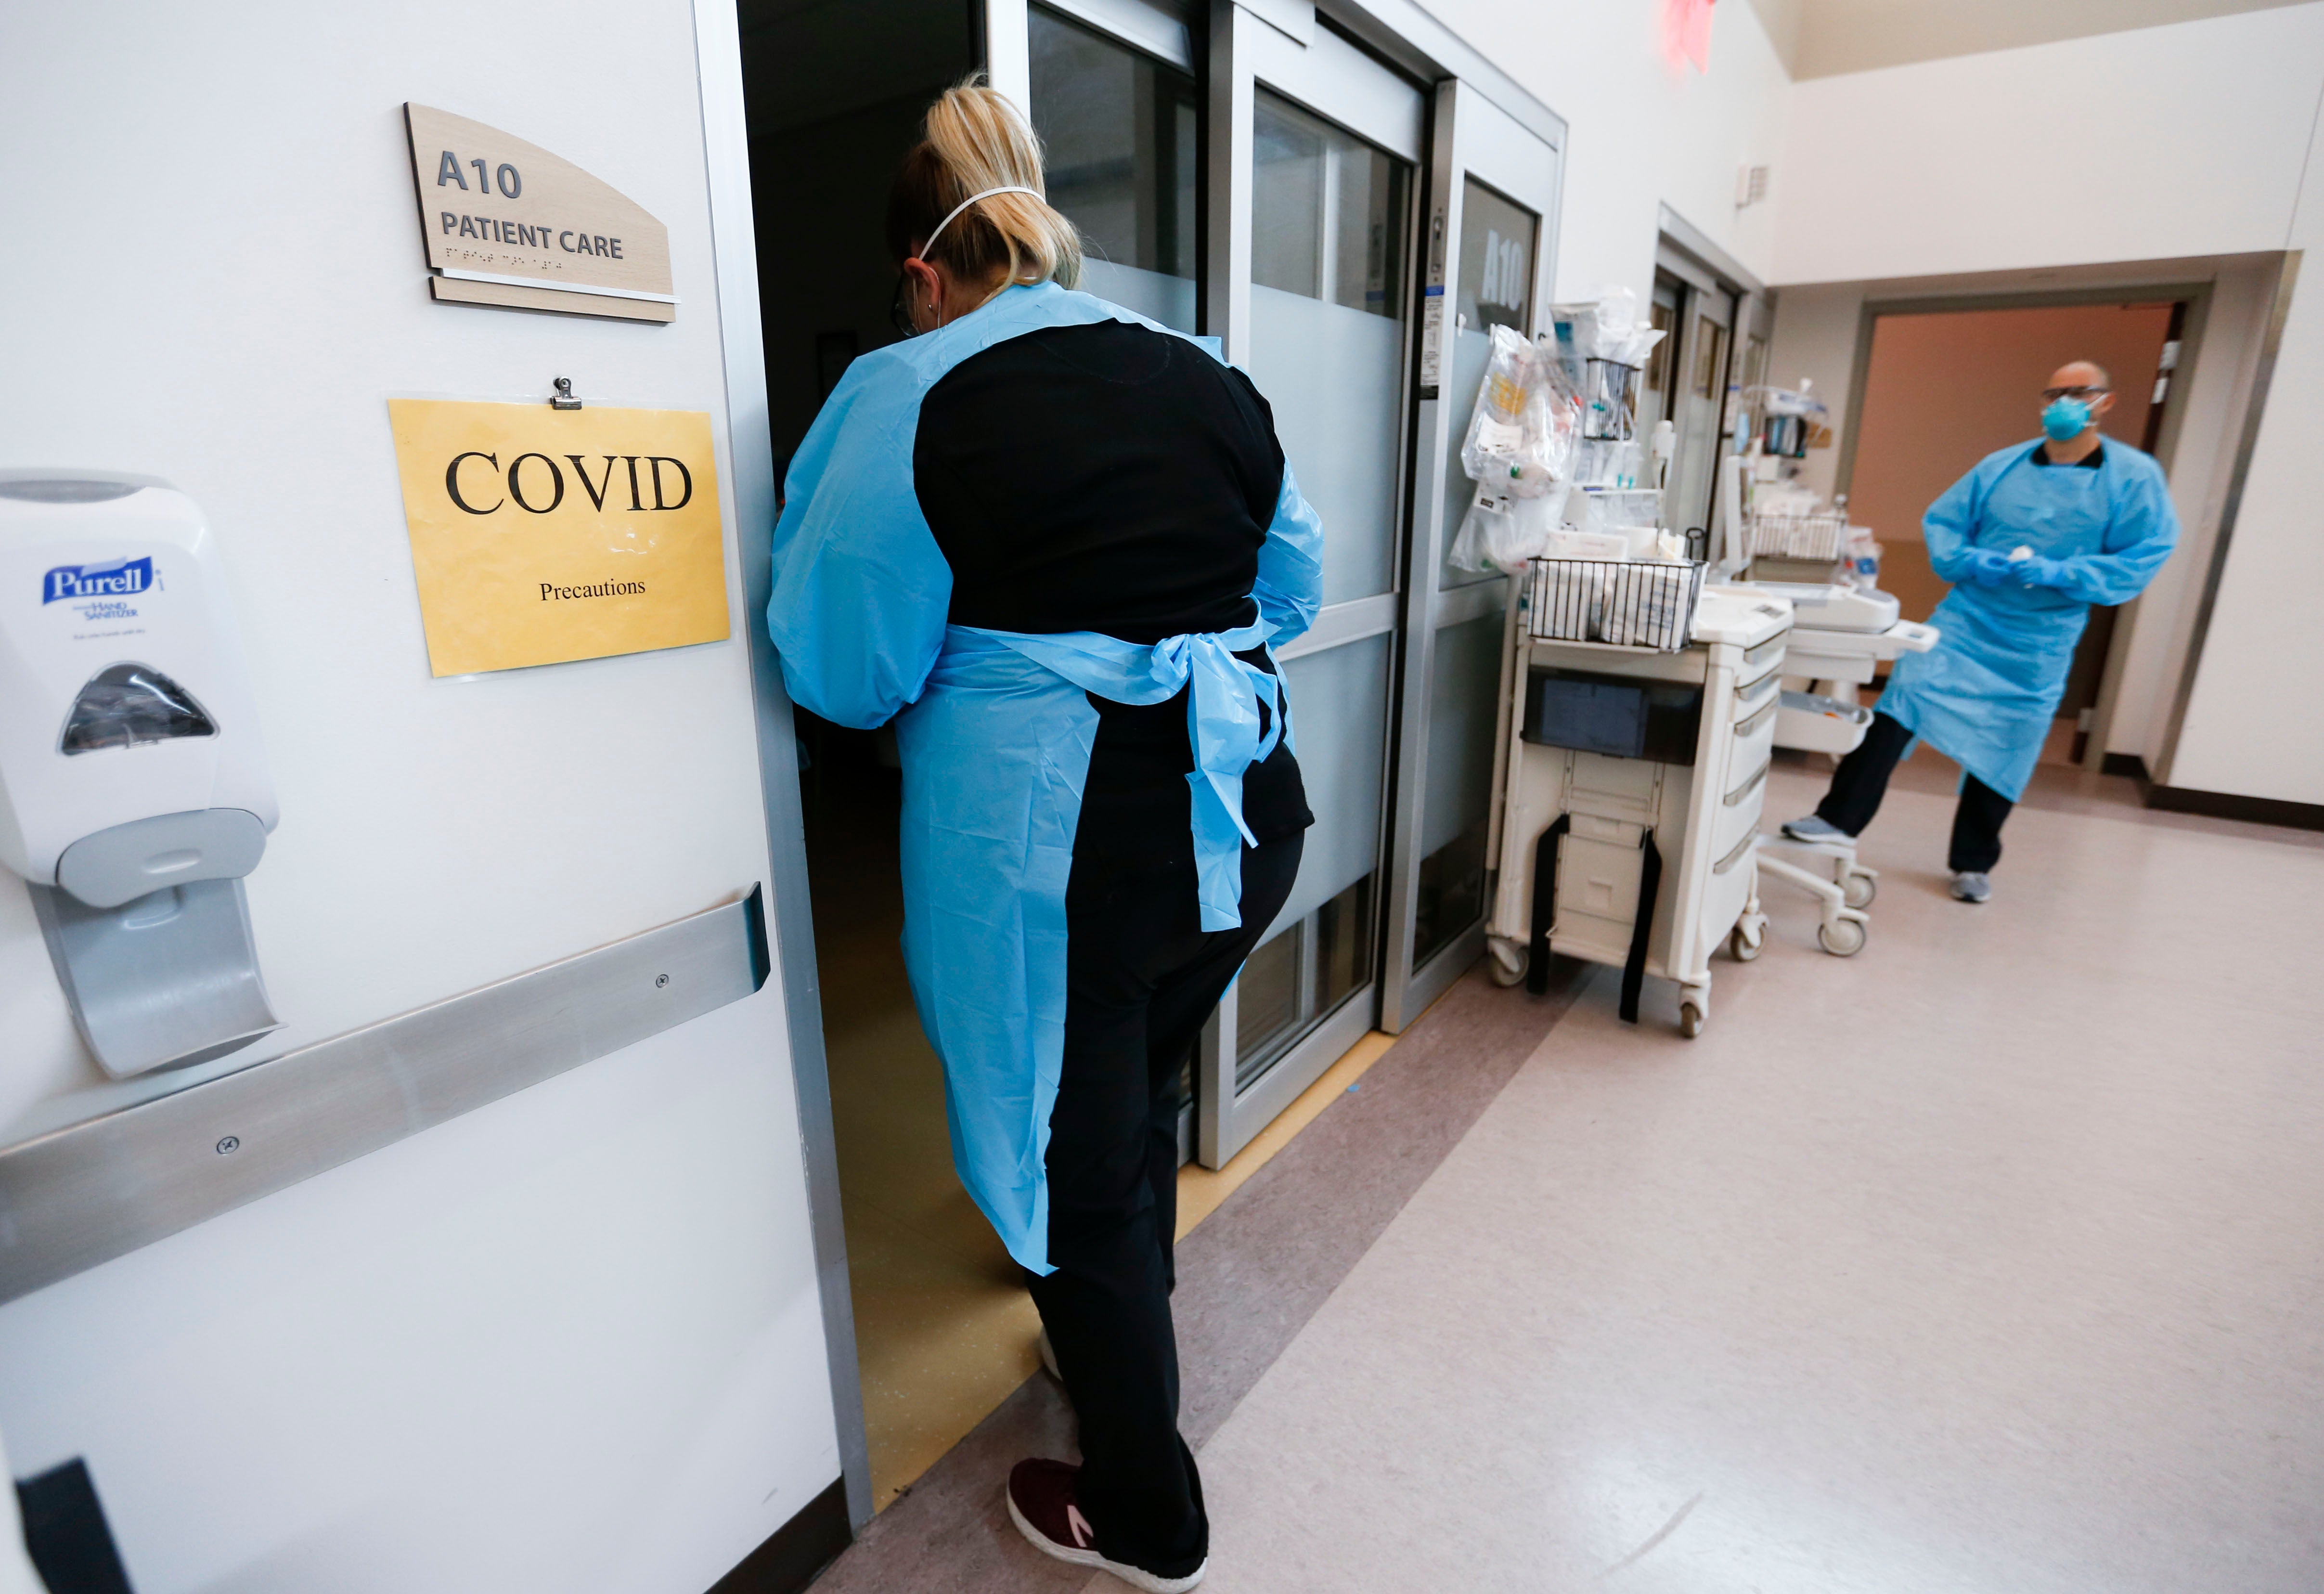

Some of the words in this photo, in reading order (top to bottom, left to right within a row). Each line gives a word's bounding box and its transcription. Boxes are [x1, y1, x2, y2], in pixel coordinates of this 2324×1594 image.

[438, 150, 522, 199] A10
[441, 212, 552, 249] PATIENT
[560, 231, 623, 259] CARE
[1482, 229, 1523, 311] A10
[445, 452, 693, 515] COVID
[52, 568, 143, 597] Purell
[538, 578, 646, 601] Precautions
